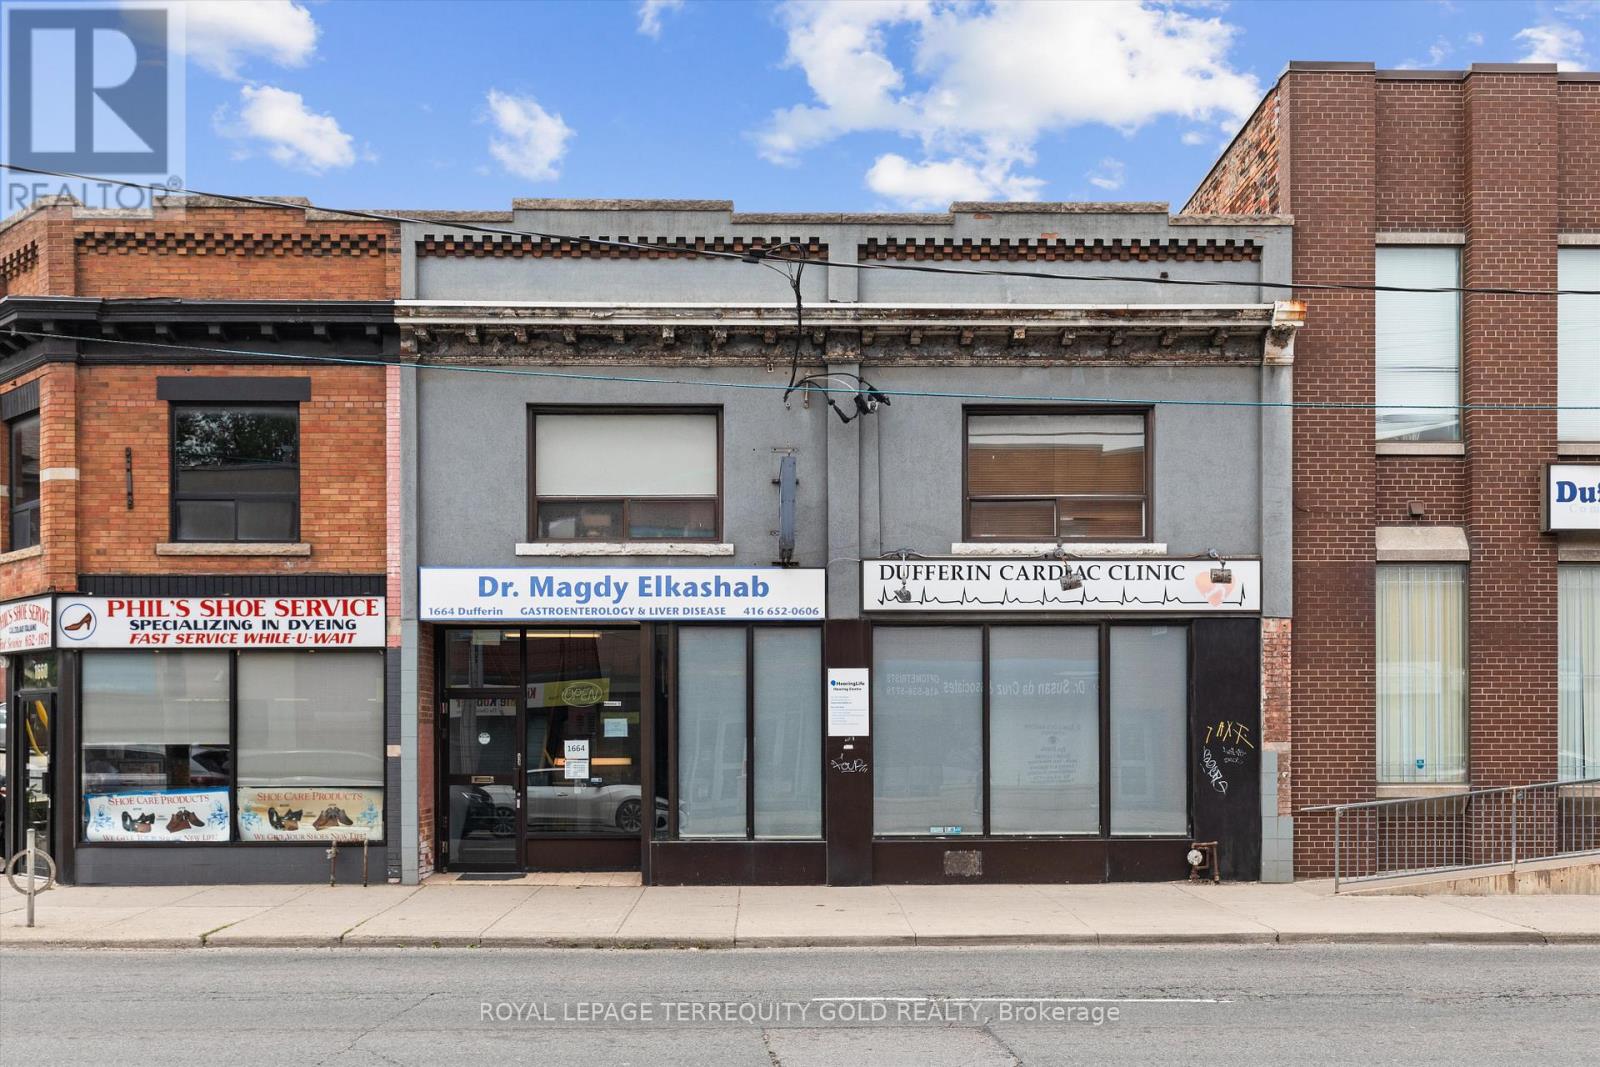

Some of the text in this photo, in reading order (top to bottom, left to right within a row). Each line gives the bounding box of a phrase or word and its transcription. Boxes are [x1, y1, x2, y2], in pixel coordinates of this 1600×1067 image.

[879, 564, 992, 581] DUFFERIN
[1108, 564, 1185, 581] CLINIC
[478, 575, 770, 605] Dr. Magdy Elkashab
[107, 598, 379, 618] PHIL'S SHOE SERVICE
[428, 606, 504, 616] 1664 Dufferin
[520, 606, 727, 616] GASTROENTEROLOGY & LIVER DISEASE
[743, 606, 820, 616] 416 652-0606
[129, 619, 357, 631] SPECIALIZING IN DYEING
[129, 632, 358, 645] FAST SERVICE WHILE-U-WAIT
[563, 686, 598, 701] OPEN
[107, 794, 210, 806] SHOE CARE PRODUCTS
[256, 791, 363, 801] SHOE CARE PRODUCTS
